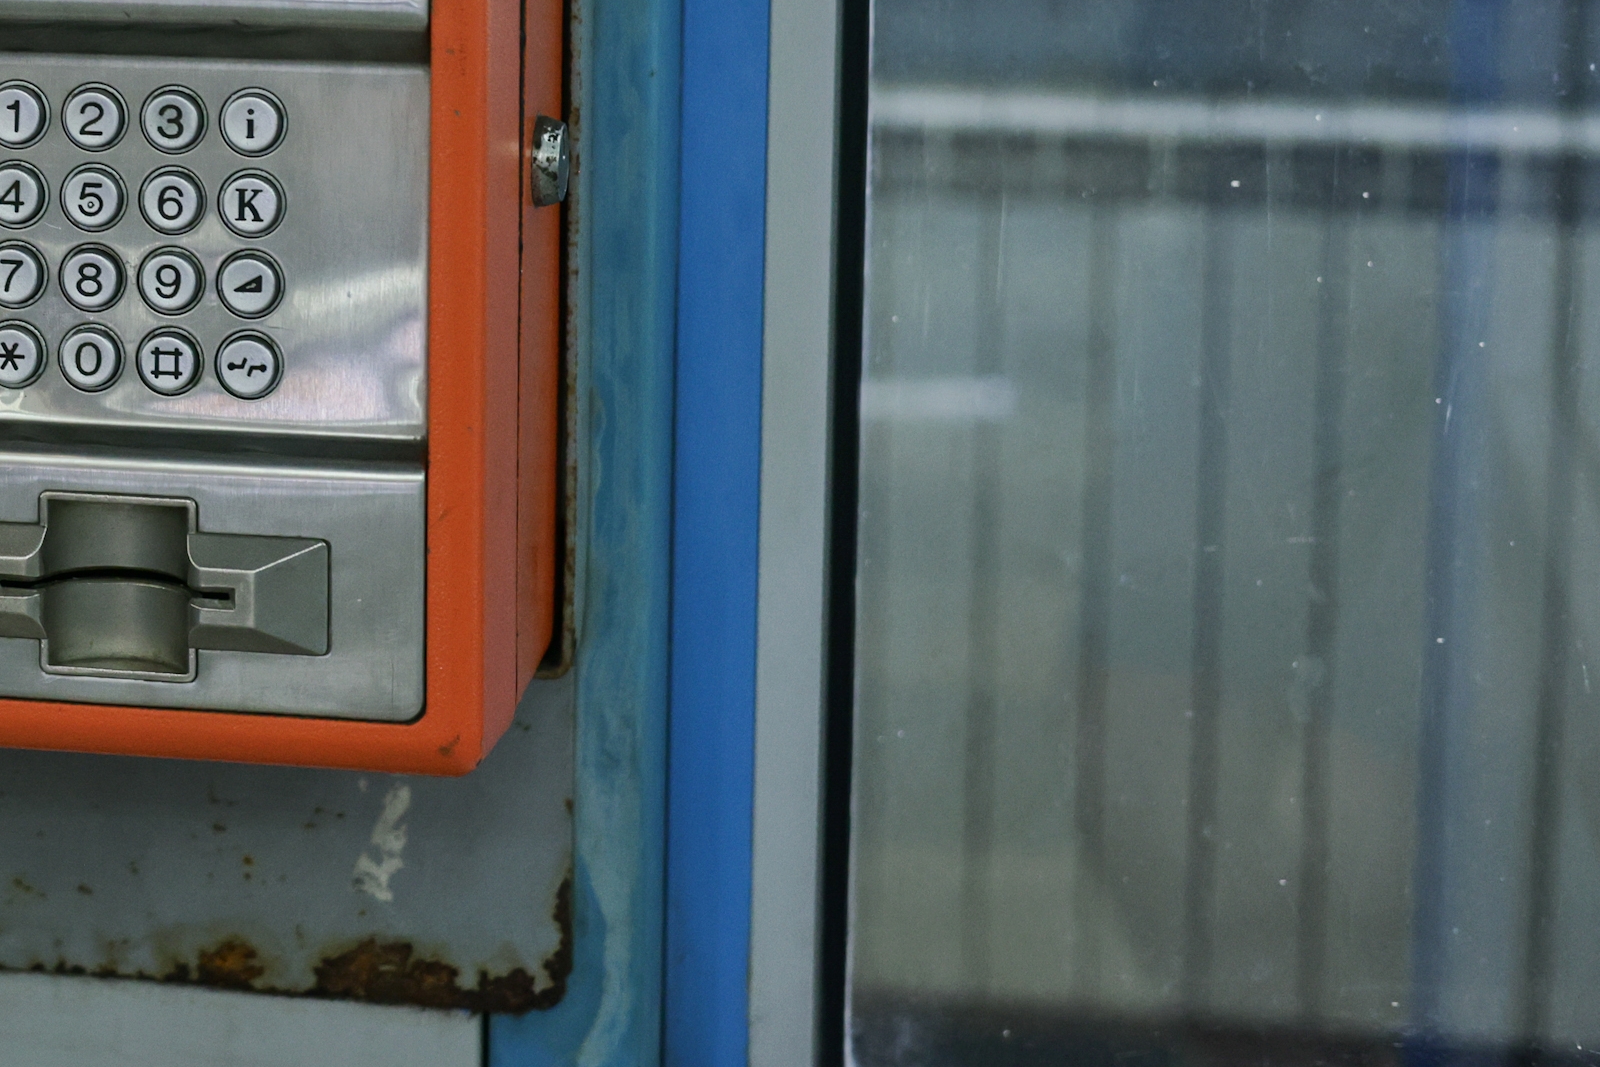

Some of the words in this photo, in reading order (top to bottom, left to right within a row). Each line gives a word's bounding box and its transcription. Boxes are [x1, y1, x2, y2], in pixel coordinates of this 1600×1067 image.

[6, 99, 21, 133] 1
[79, 101, 105, 136] 2
[156, 103, 184, 140] 3
[77, 182, 104, 217] 5
[157, 185, 184, 221] 6
[234, 188, 264, 223] K
[0, 258, 24, 293] 7
[75, 262, 103, 297] 8
[155, 264, 182, 299] 9
[74, 341, 103, 377] 0
